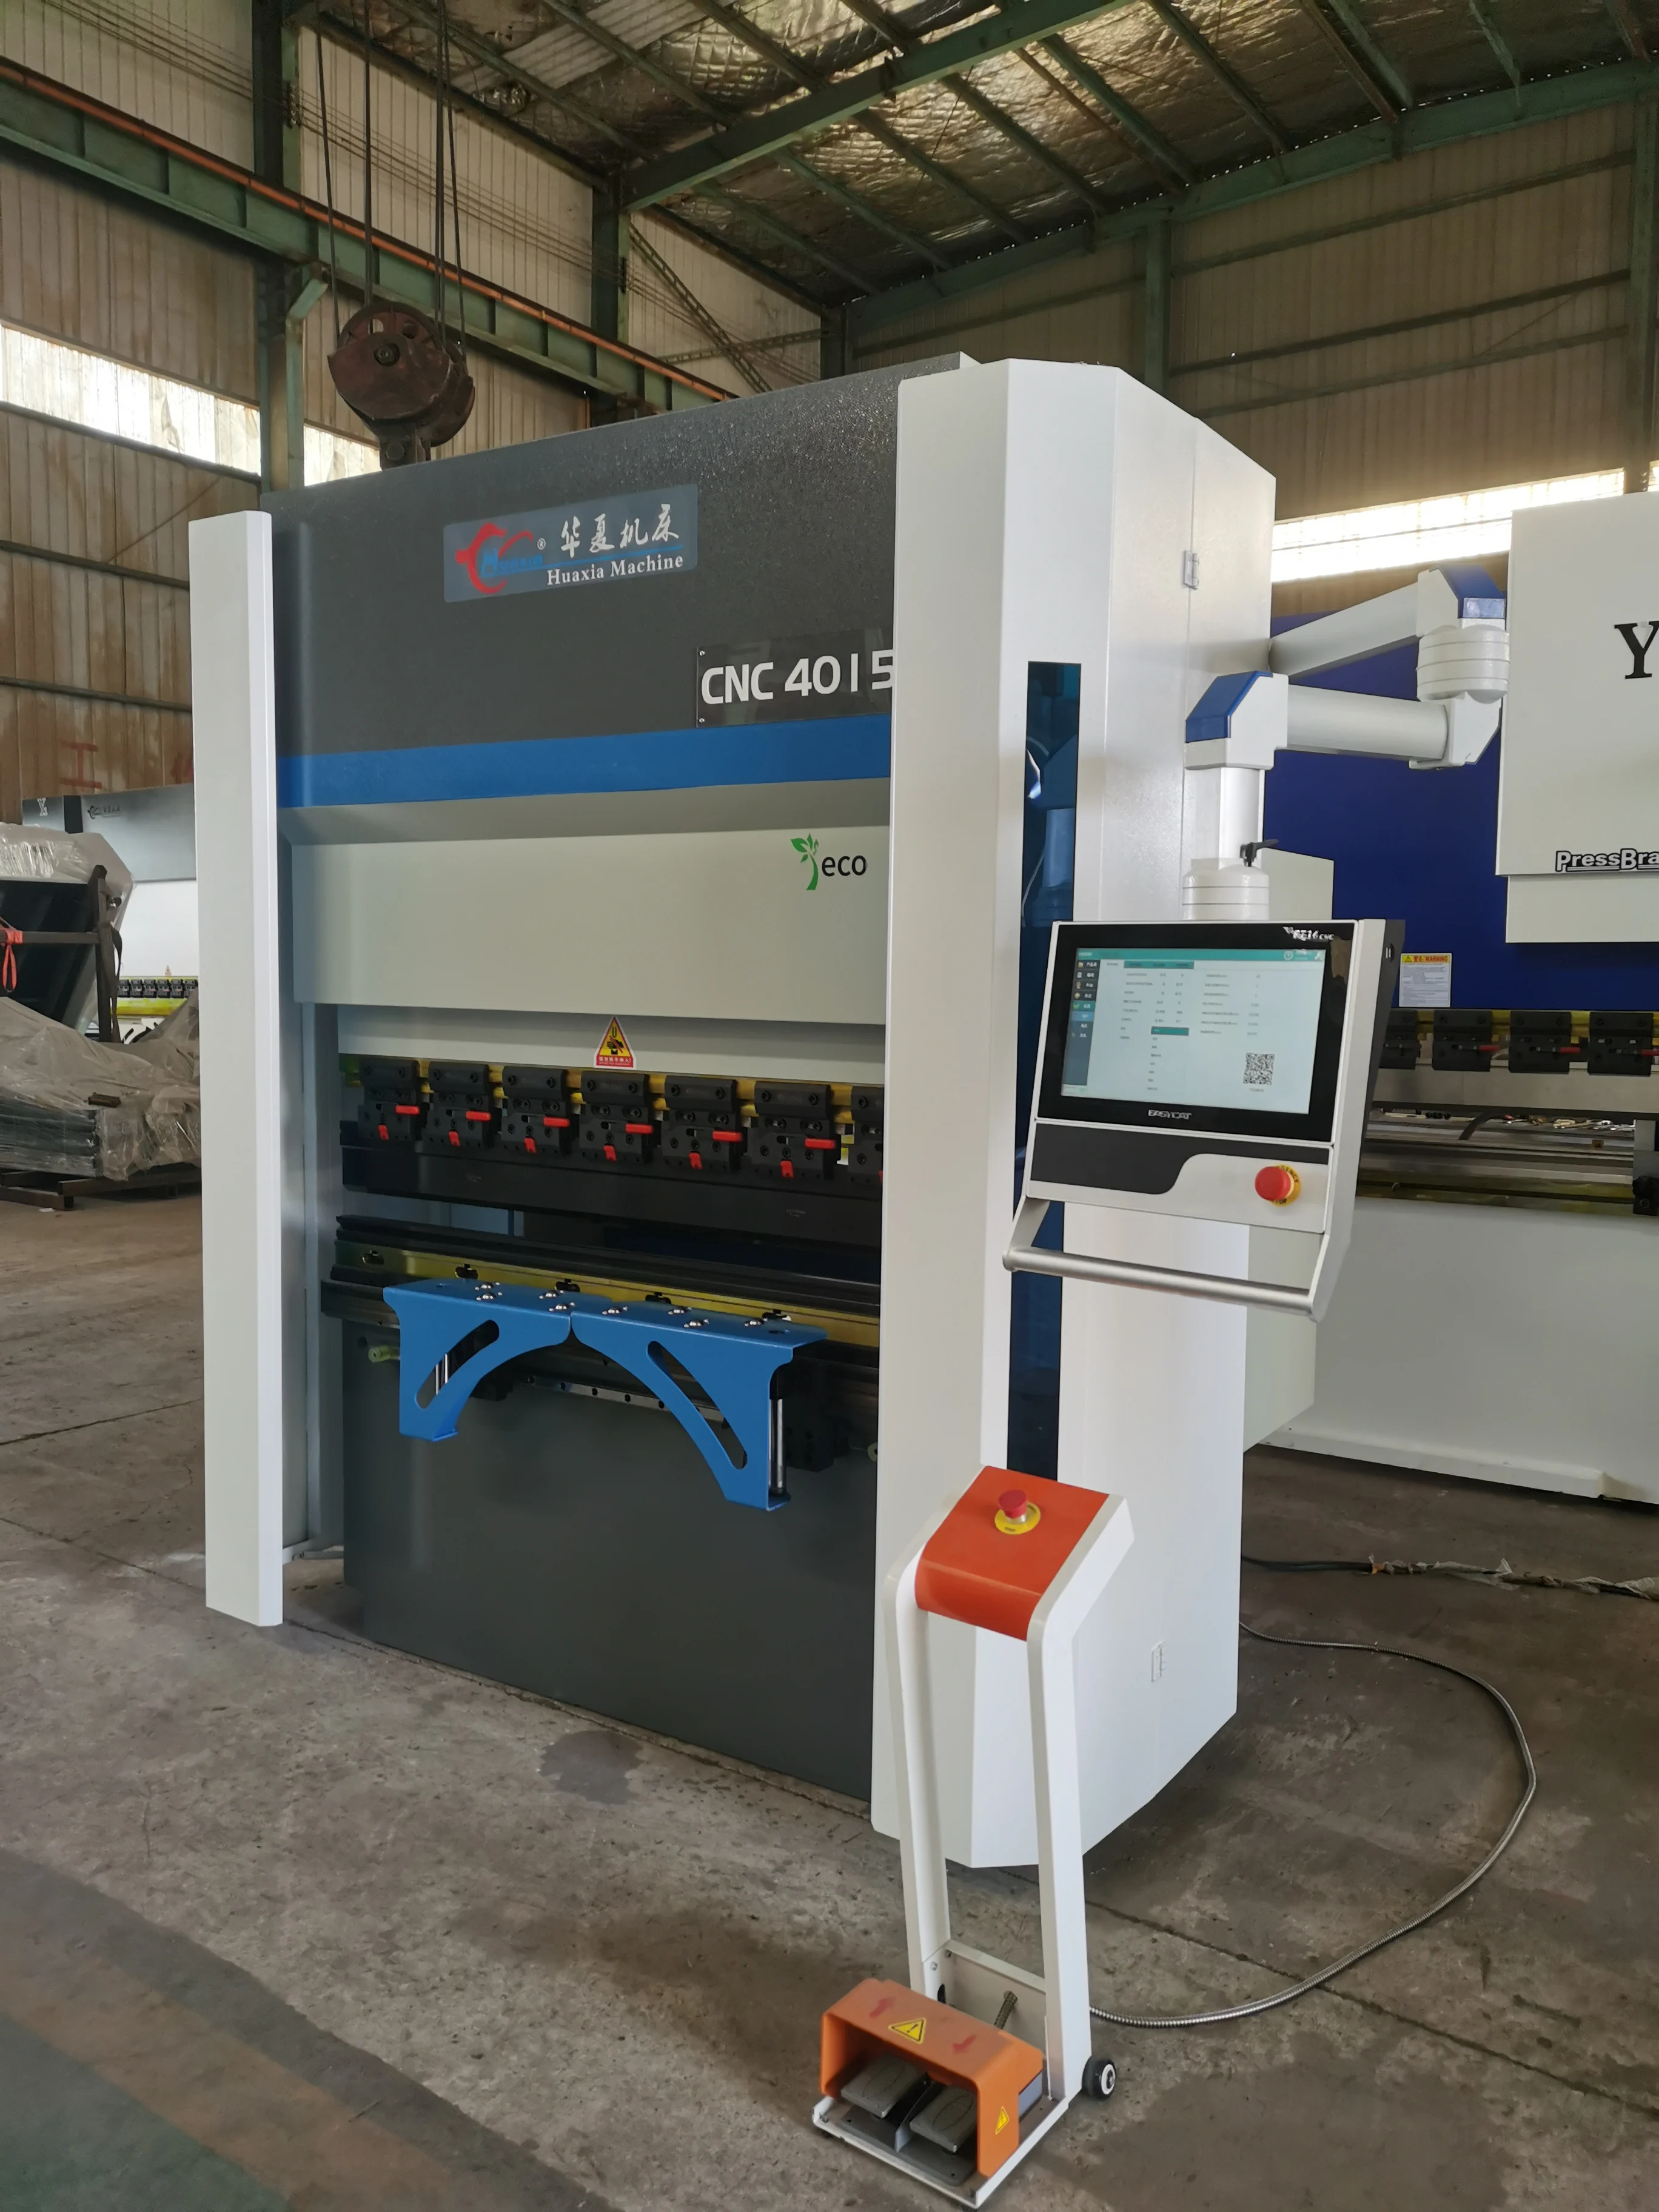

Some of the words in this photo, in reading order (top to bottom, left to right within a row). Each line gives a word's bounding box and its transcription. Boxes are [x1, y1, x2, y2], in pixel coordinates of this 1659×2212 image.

[560, 503, 680, 558] 华夏机床
[547, 566, 605, 585] Huaxia
[610, 555, 683, 577] Machine
[701, 662, 774, 705] CNC
[821, 855, 868, 877] eco
[1555, 848, 1659, 872] PressBra
